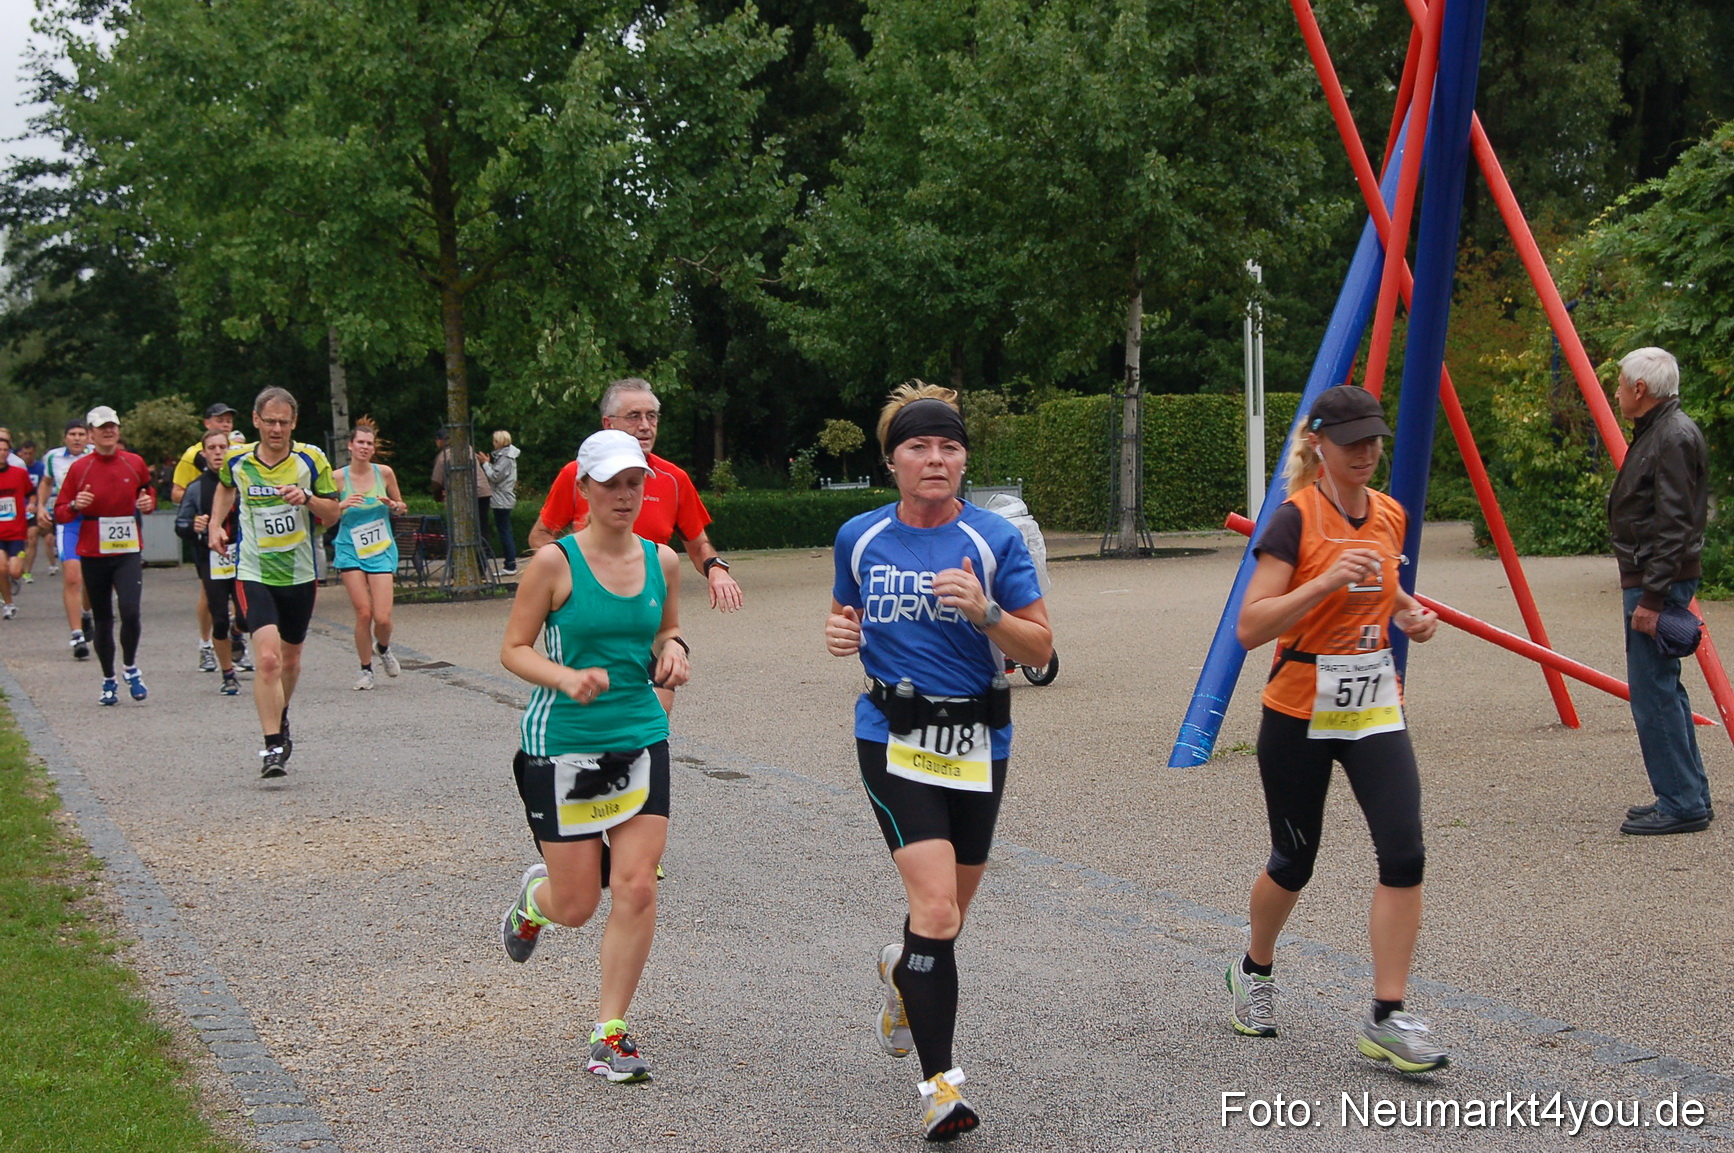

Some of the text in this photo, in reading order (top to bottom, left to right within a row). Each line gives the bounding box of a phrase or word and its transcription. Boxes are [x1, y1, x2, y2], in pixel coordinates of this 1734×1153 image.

[108, 526, 131, 539] 234
[264, 515, 295, 535] 560
[360, 529, 380, 546] 577
[869, 564, 938, 594] Fitne
[1335, 673, 1382, 708] 571
[1324, 711, 1374, 727] MARA
[912, 753, 962, 777] Claudia
[591, 802, 620, 820] Julia
